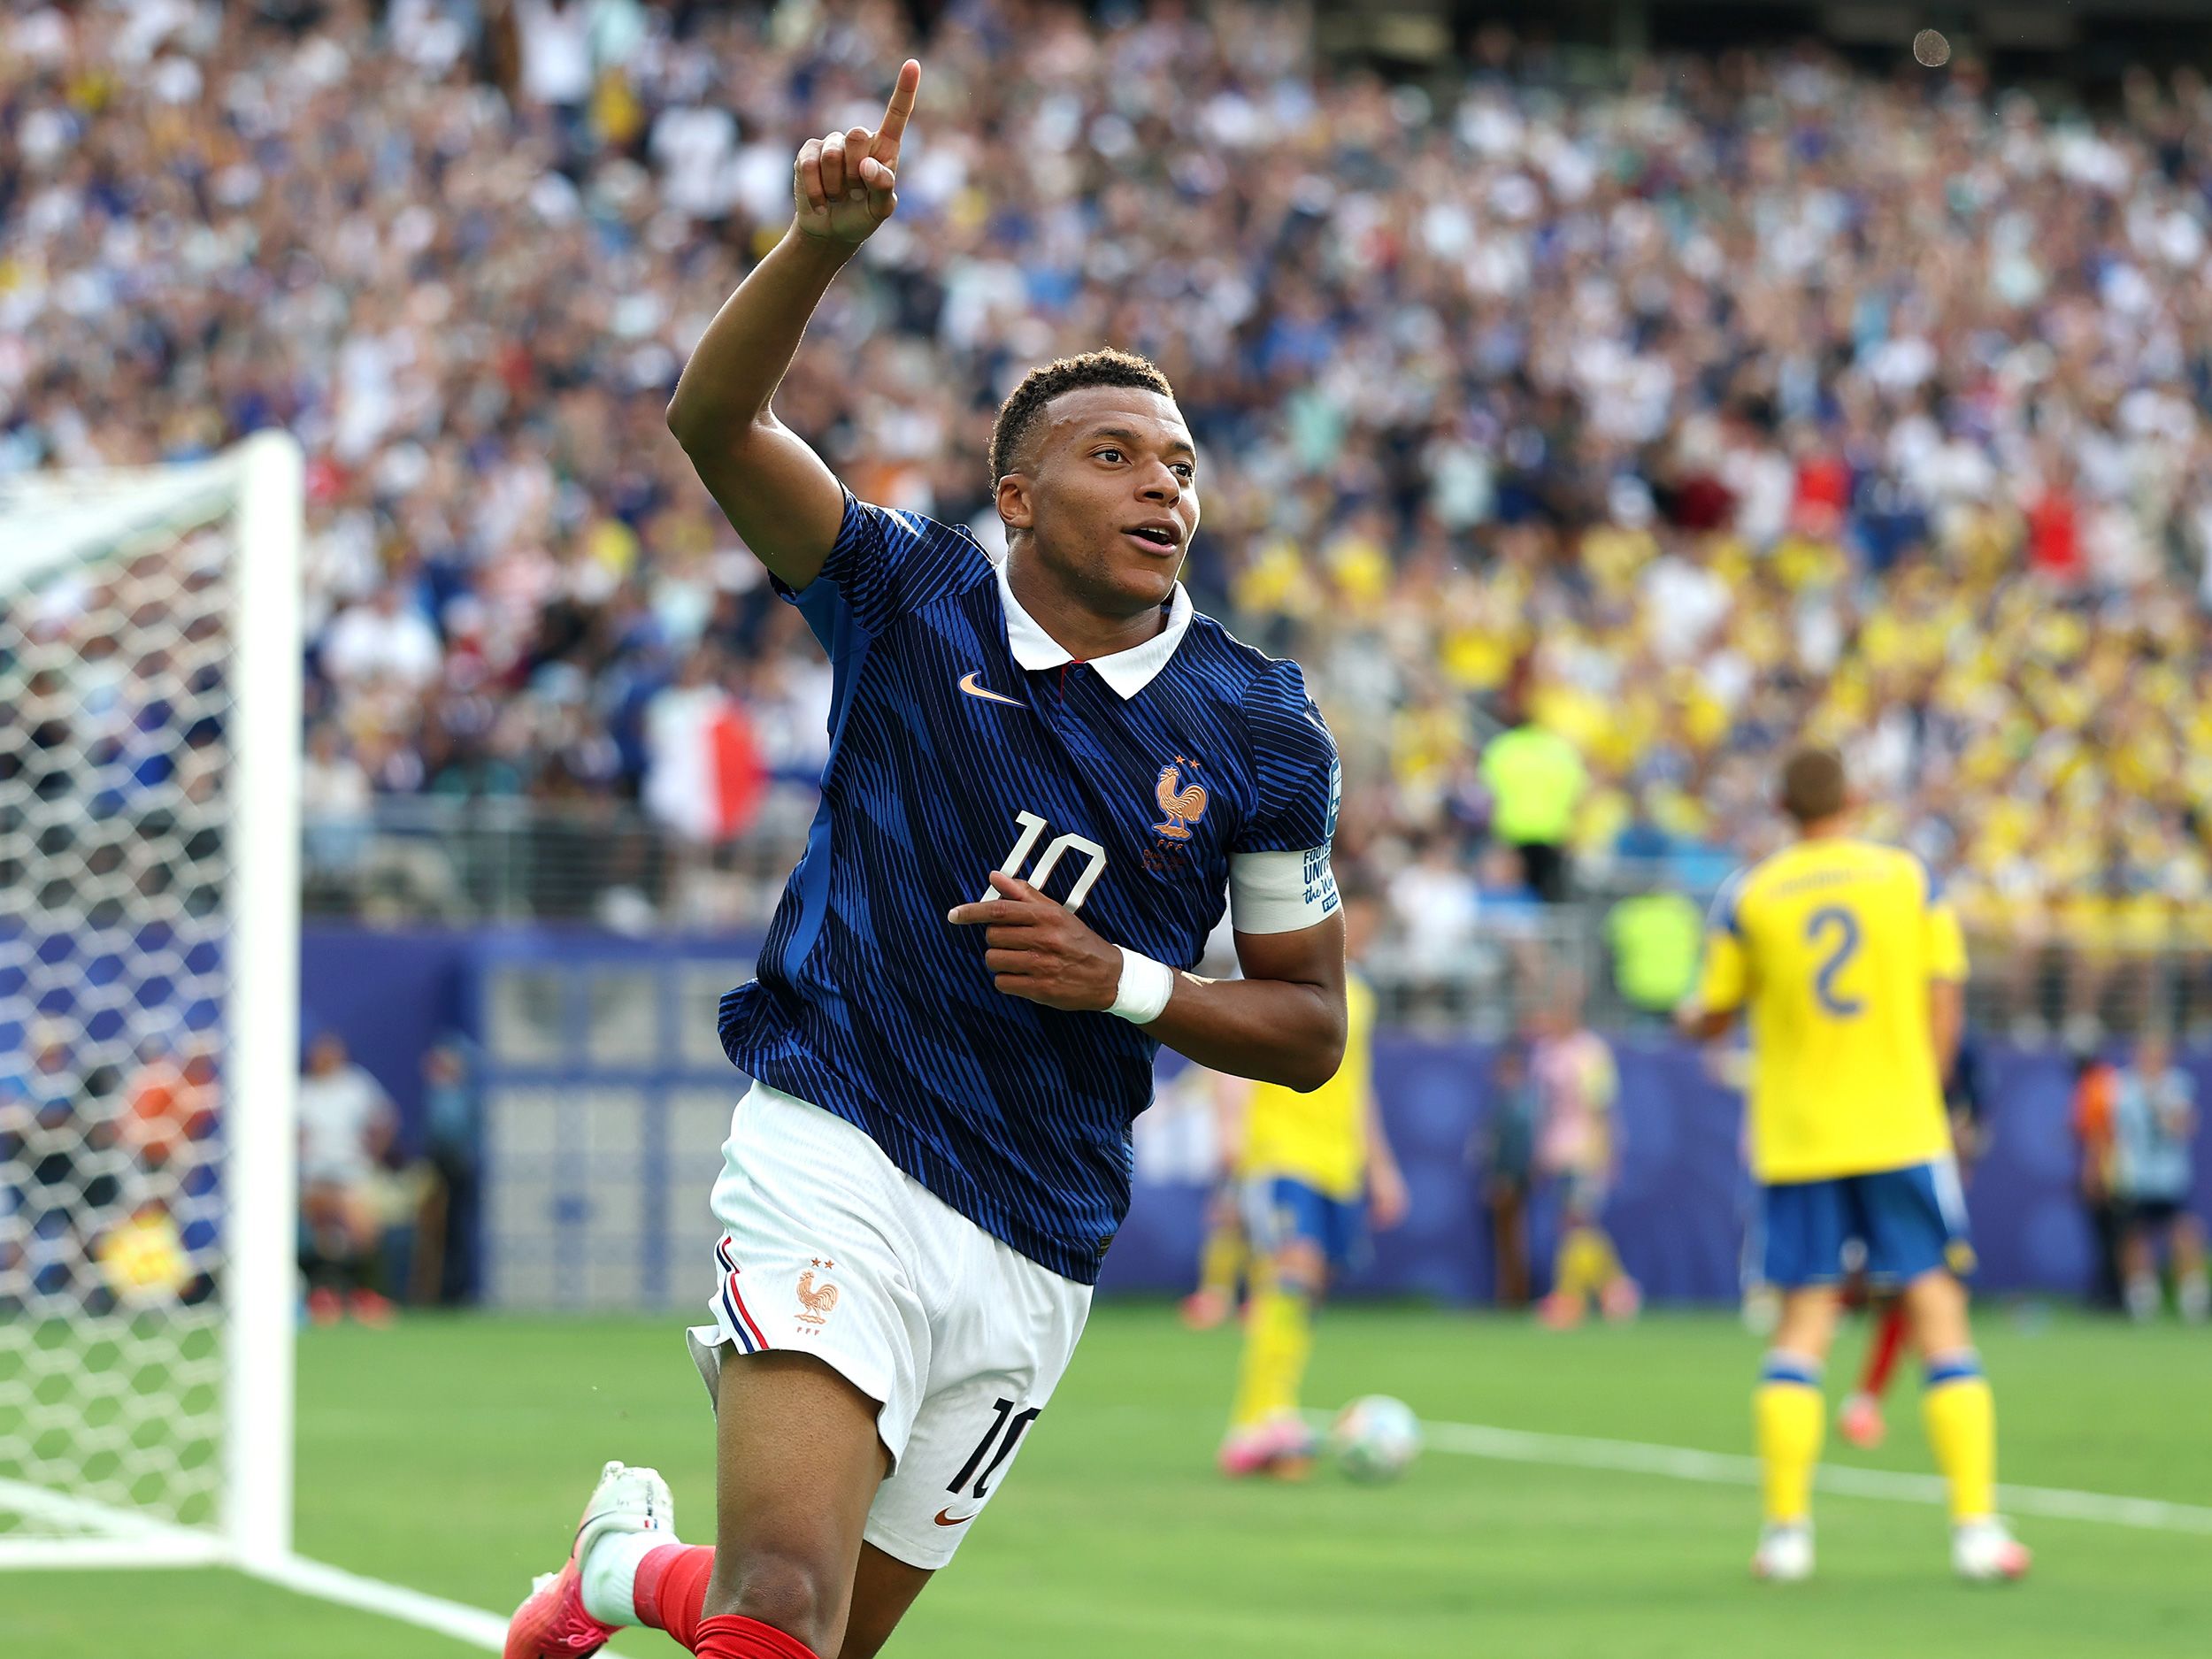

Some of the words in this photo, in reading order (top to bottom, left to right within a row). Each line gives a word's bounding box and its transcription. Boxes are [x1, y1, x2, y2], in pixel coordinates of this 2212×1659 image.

[979, 810, 1108, 915] 10
[1302, 886, 1321, 904] the
[1809, 905, 1861, 1017] 2
